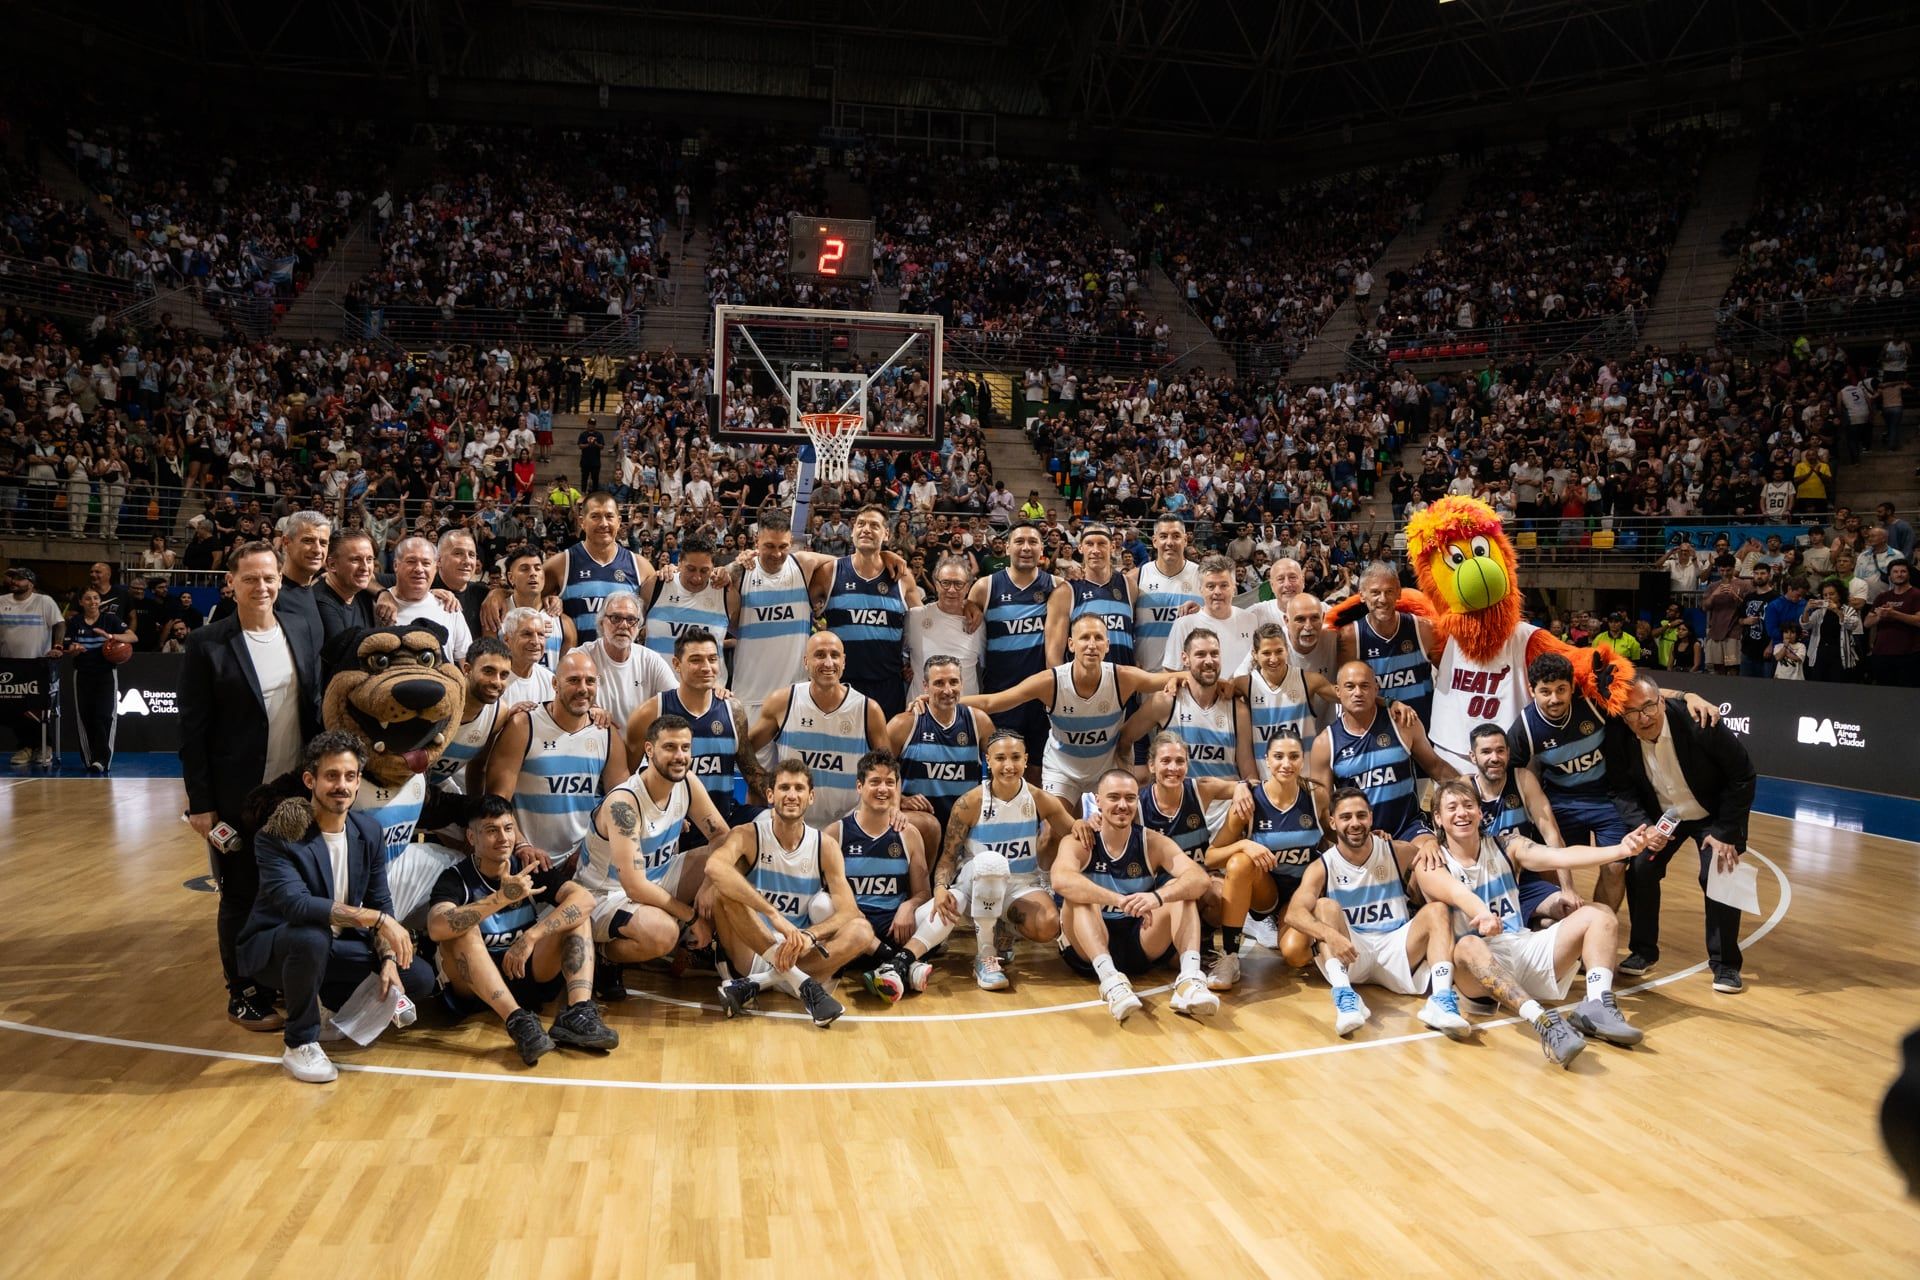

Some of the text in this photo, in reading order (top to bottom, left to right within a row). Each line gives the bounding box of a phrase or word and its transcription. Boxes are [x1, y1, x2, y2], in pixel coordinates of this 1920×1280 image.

[818, 239, 844, 274] 2
[1770, 499, 1784, 508] 20
[582, 597, 604, 612] VI
[755, 604, 795, 622] VISA
[848, 609, 888, 625] VISA
[1150, 607, 1180, 622] VIS
[1004, 616, 1044, 634] VISA
[0, 681, 39, 694] LDING
[1376, 669, 1416, 689] VISA
[1452, 664, 1510, 695] HEAT
[117, 688, 149, 715] A
[143, 690, 177, 699] Buenos
[151, 705, 179, 714] Ciuda
[1467, 695, 1501, 719] 00
[1723, 717, 1750, 734] DING
[1797, 716, 1837, 747] BA
[1833, 721, 1860, 732] Buenos
[1837, 730, 1857, 739] Aires
[1064, 729, 1108, 745] VISA
[1839, 737, 1865, 747] Ciudad
[798, 750, 844, 772] VISA
[1187, 744, 1225, 761] VISA
[432, 758, 458, 774] SA
[691, 756, 722, 774] ISA
[922, 762, 966, 781] VISA
[1557, 750, 1603, 775] VISA
[544, 775, 593, 794] VISA
[1351, 766, 1397, 790] VISA
[849, 876, 898, 897] VISA
[1341, 902, 1394, 925] VISA
[1490, 897, 1515, 918] SA
